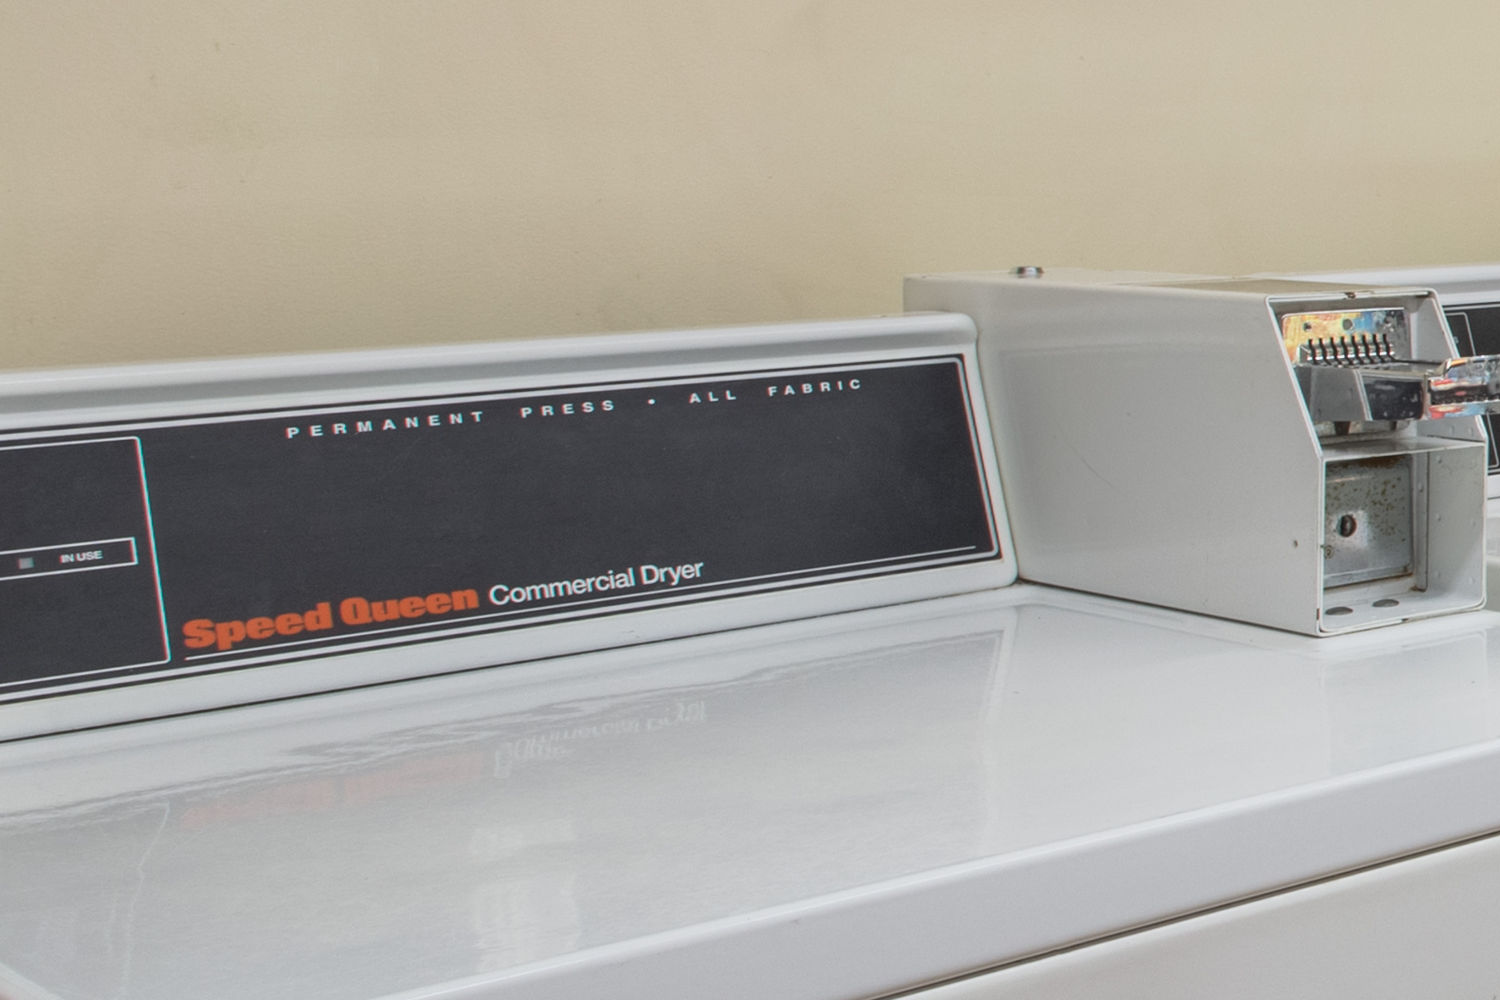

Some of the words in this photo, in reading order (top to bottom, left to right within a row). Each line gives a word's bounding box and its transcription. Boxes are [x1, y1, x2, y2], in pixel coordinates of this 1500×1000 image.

[286, 411, 485, 439] PERMANENT
[520, 399, 614, 419] PRESS
[689, 389, 737, 404] ALL
[767, 378, 862, 397] FABRIC
[59, 554, 75, 564] IN
[75, 550, 103, 562] USE
[183, 602, 333, 651] Speed
[339, 589, 480, 626] Queen
[488, 567, 636, 606] Commercial
[640, 559, 704, 586] Dryer
